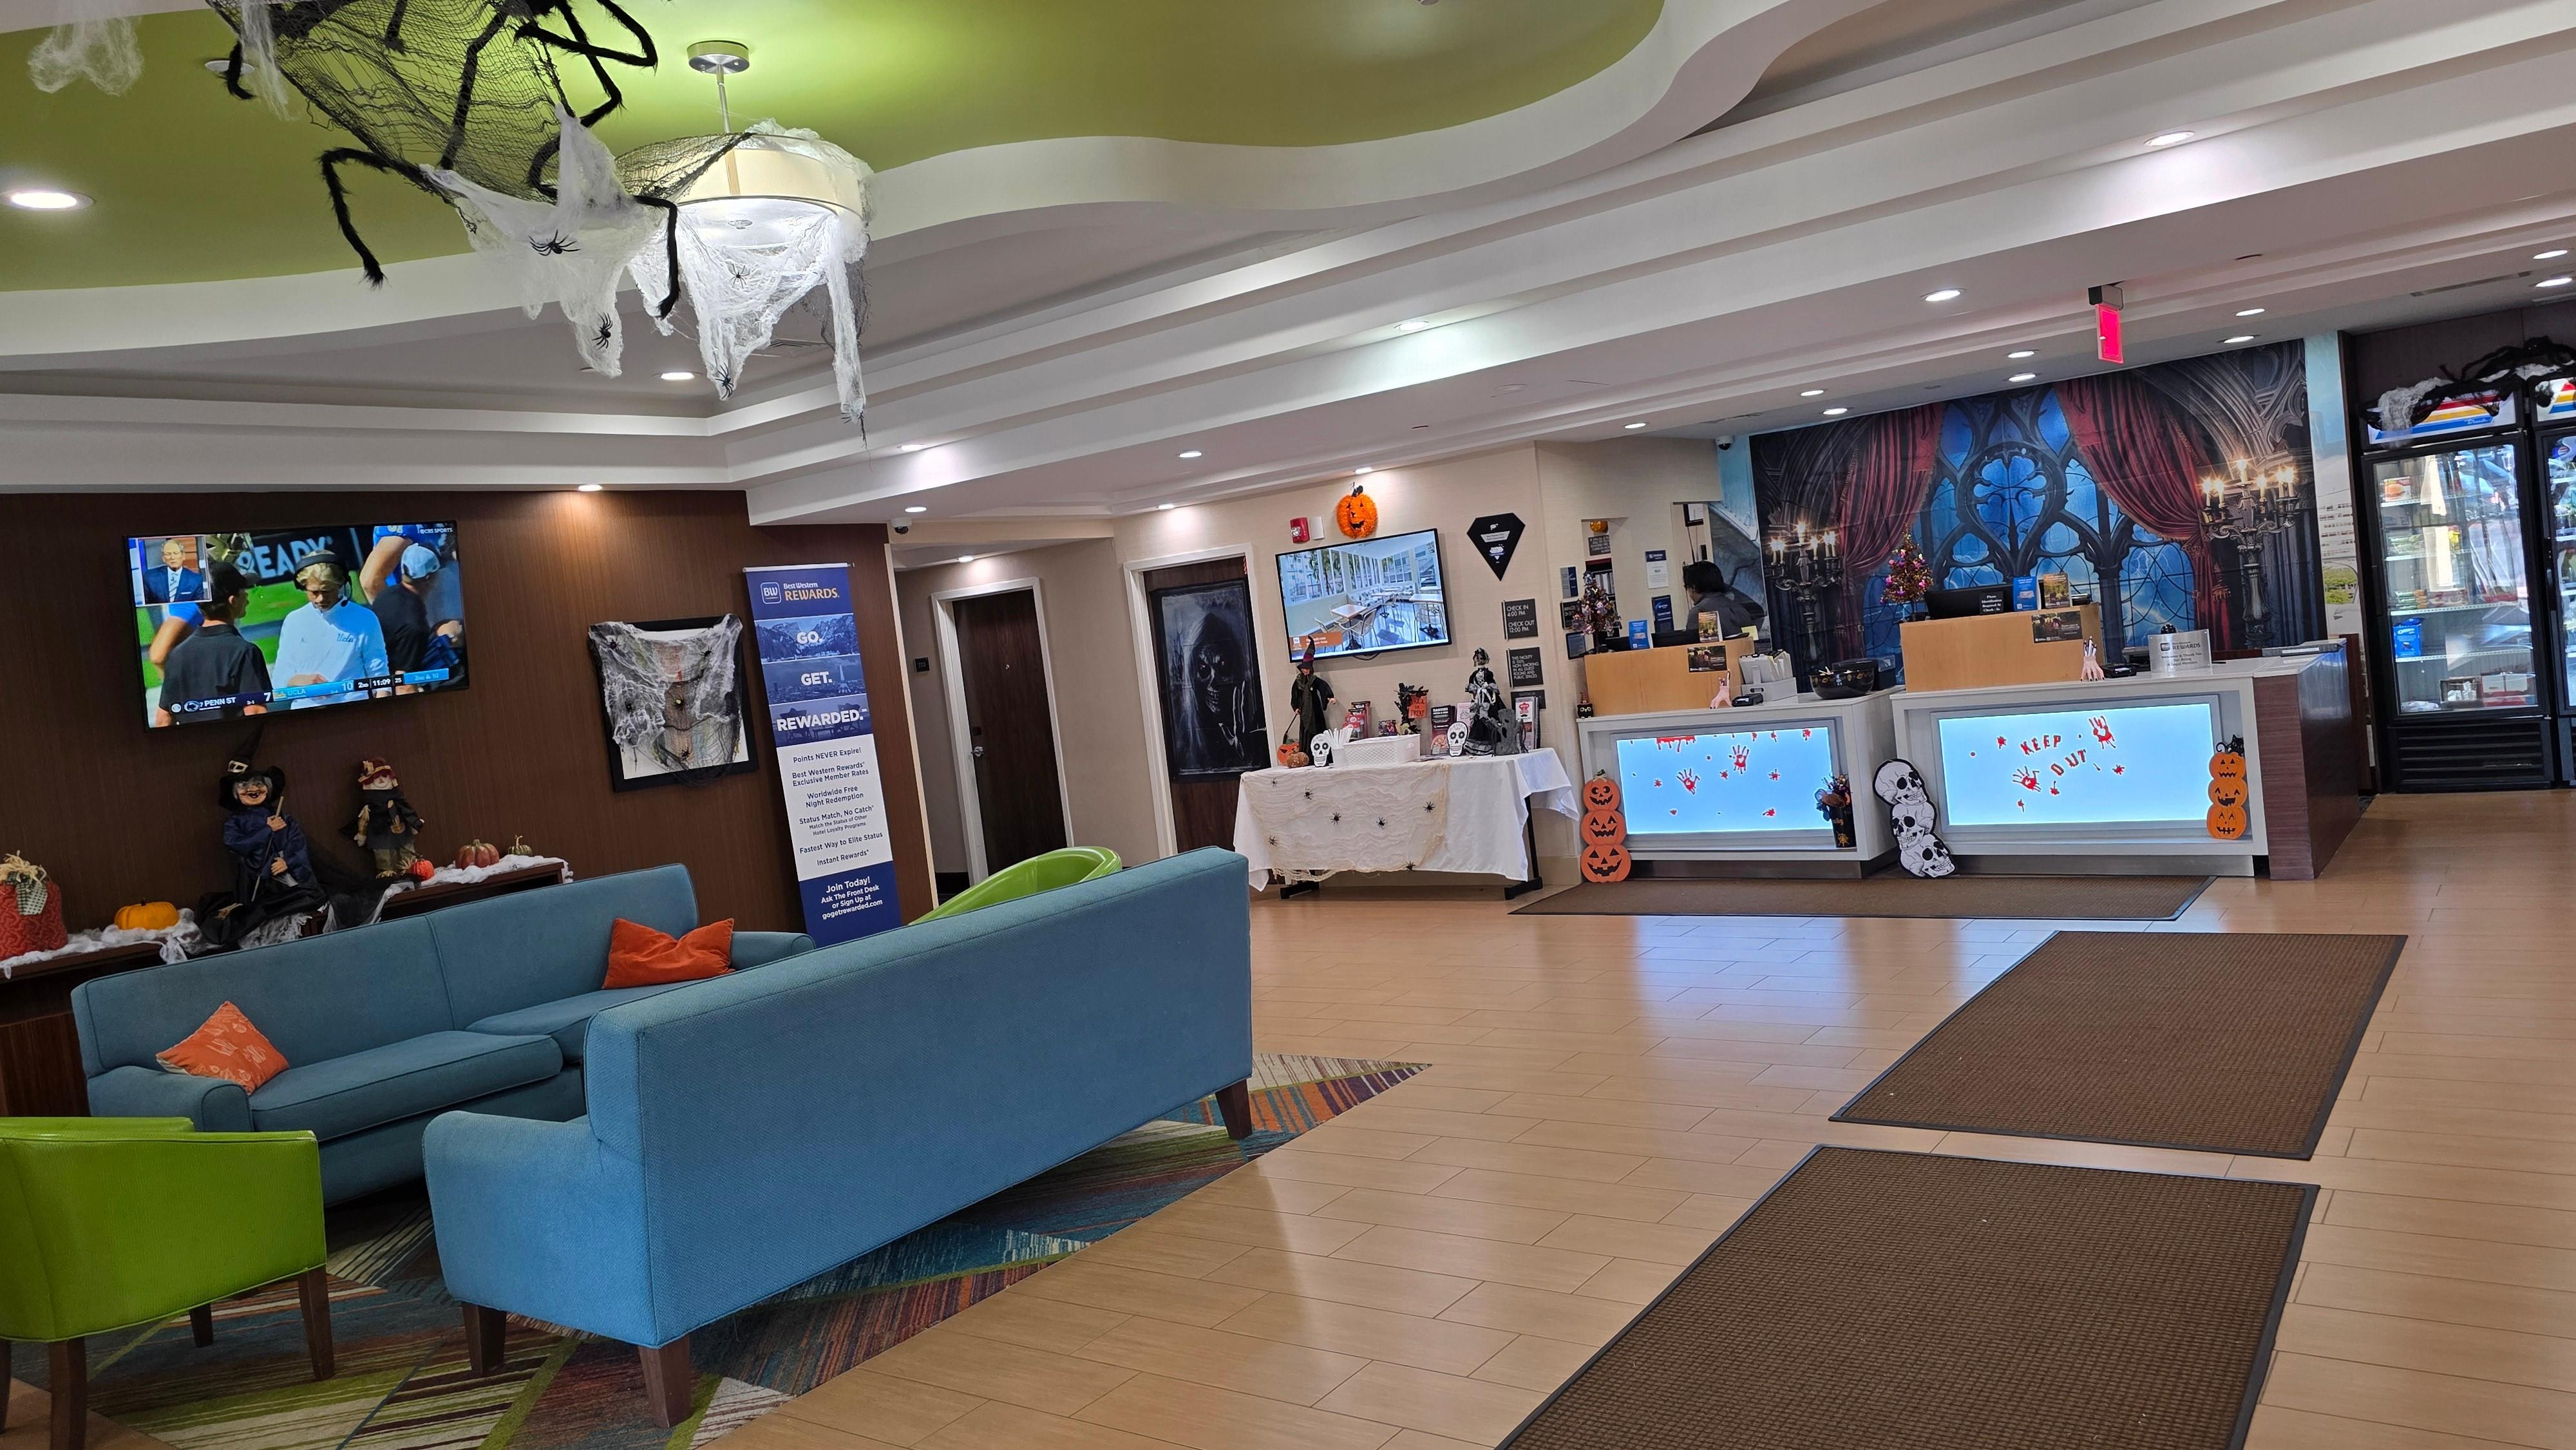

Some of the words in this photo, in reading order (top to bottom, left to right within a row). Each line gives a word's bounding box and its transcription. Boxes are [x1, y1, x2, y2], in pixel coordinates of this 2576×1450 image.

[763, 587, 778, 596] BW
[797, 631, 823, 644] GO.
[372, 678, 392, 686] 11:09
[801, 671, 832, 685] GET.
[341, 682, 354, 691] 10
[204, 698, 225, 707] PENN
[263, 692, 271, 702] 7
[2020, 735, 2061, 756] KEEP
[793, 754, 813, 763] Points
[815, 751, 838, 760] NEVER
[839, 747, 862, 756] Expire!
[2050, 749, 2087, 776] OUT
[808, 767, 835, 777] Western
[793, 777, 823, 786] Exclusive
[824, 773, 849, 781] Member
[806, 799, 824, 808] Night
[826, 792, 864, 804] Redemption
[807, 789, 842, 799] Worldwide
[799, 816, 820, 824] Status
[822, 812, 842, 820] Match,
[827, 825, 844, 834] Loyalty
[800, 844, 822, 854] Fastest
[848, 836, 862, 844] Elite
[864, 832, 883, 840] Status
[817, 855, 839, 865] Instant
[826, 883, 844, 893] Join
[844, 876, 871, 889] Today!
[846, 889, 864, 898] Front
[865, 885, 880, 893] Desk
[840, 898, 854, 907] Sign
[855, 895, 864, 903] Up
[822, 899, 883, 919] gogetrewarded.com
